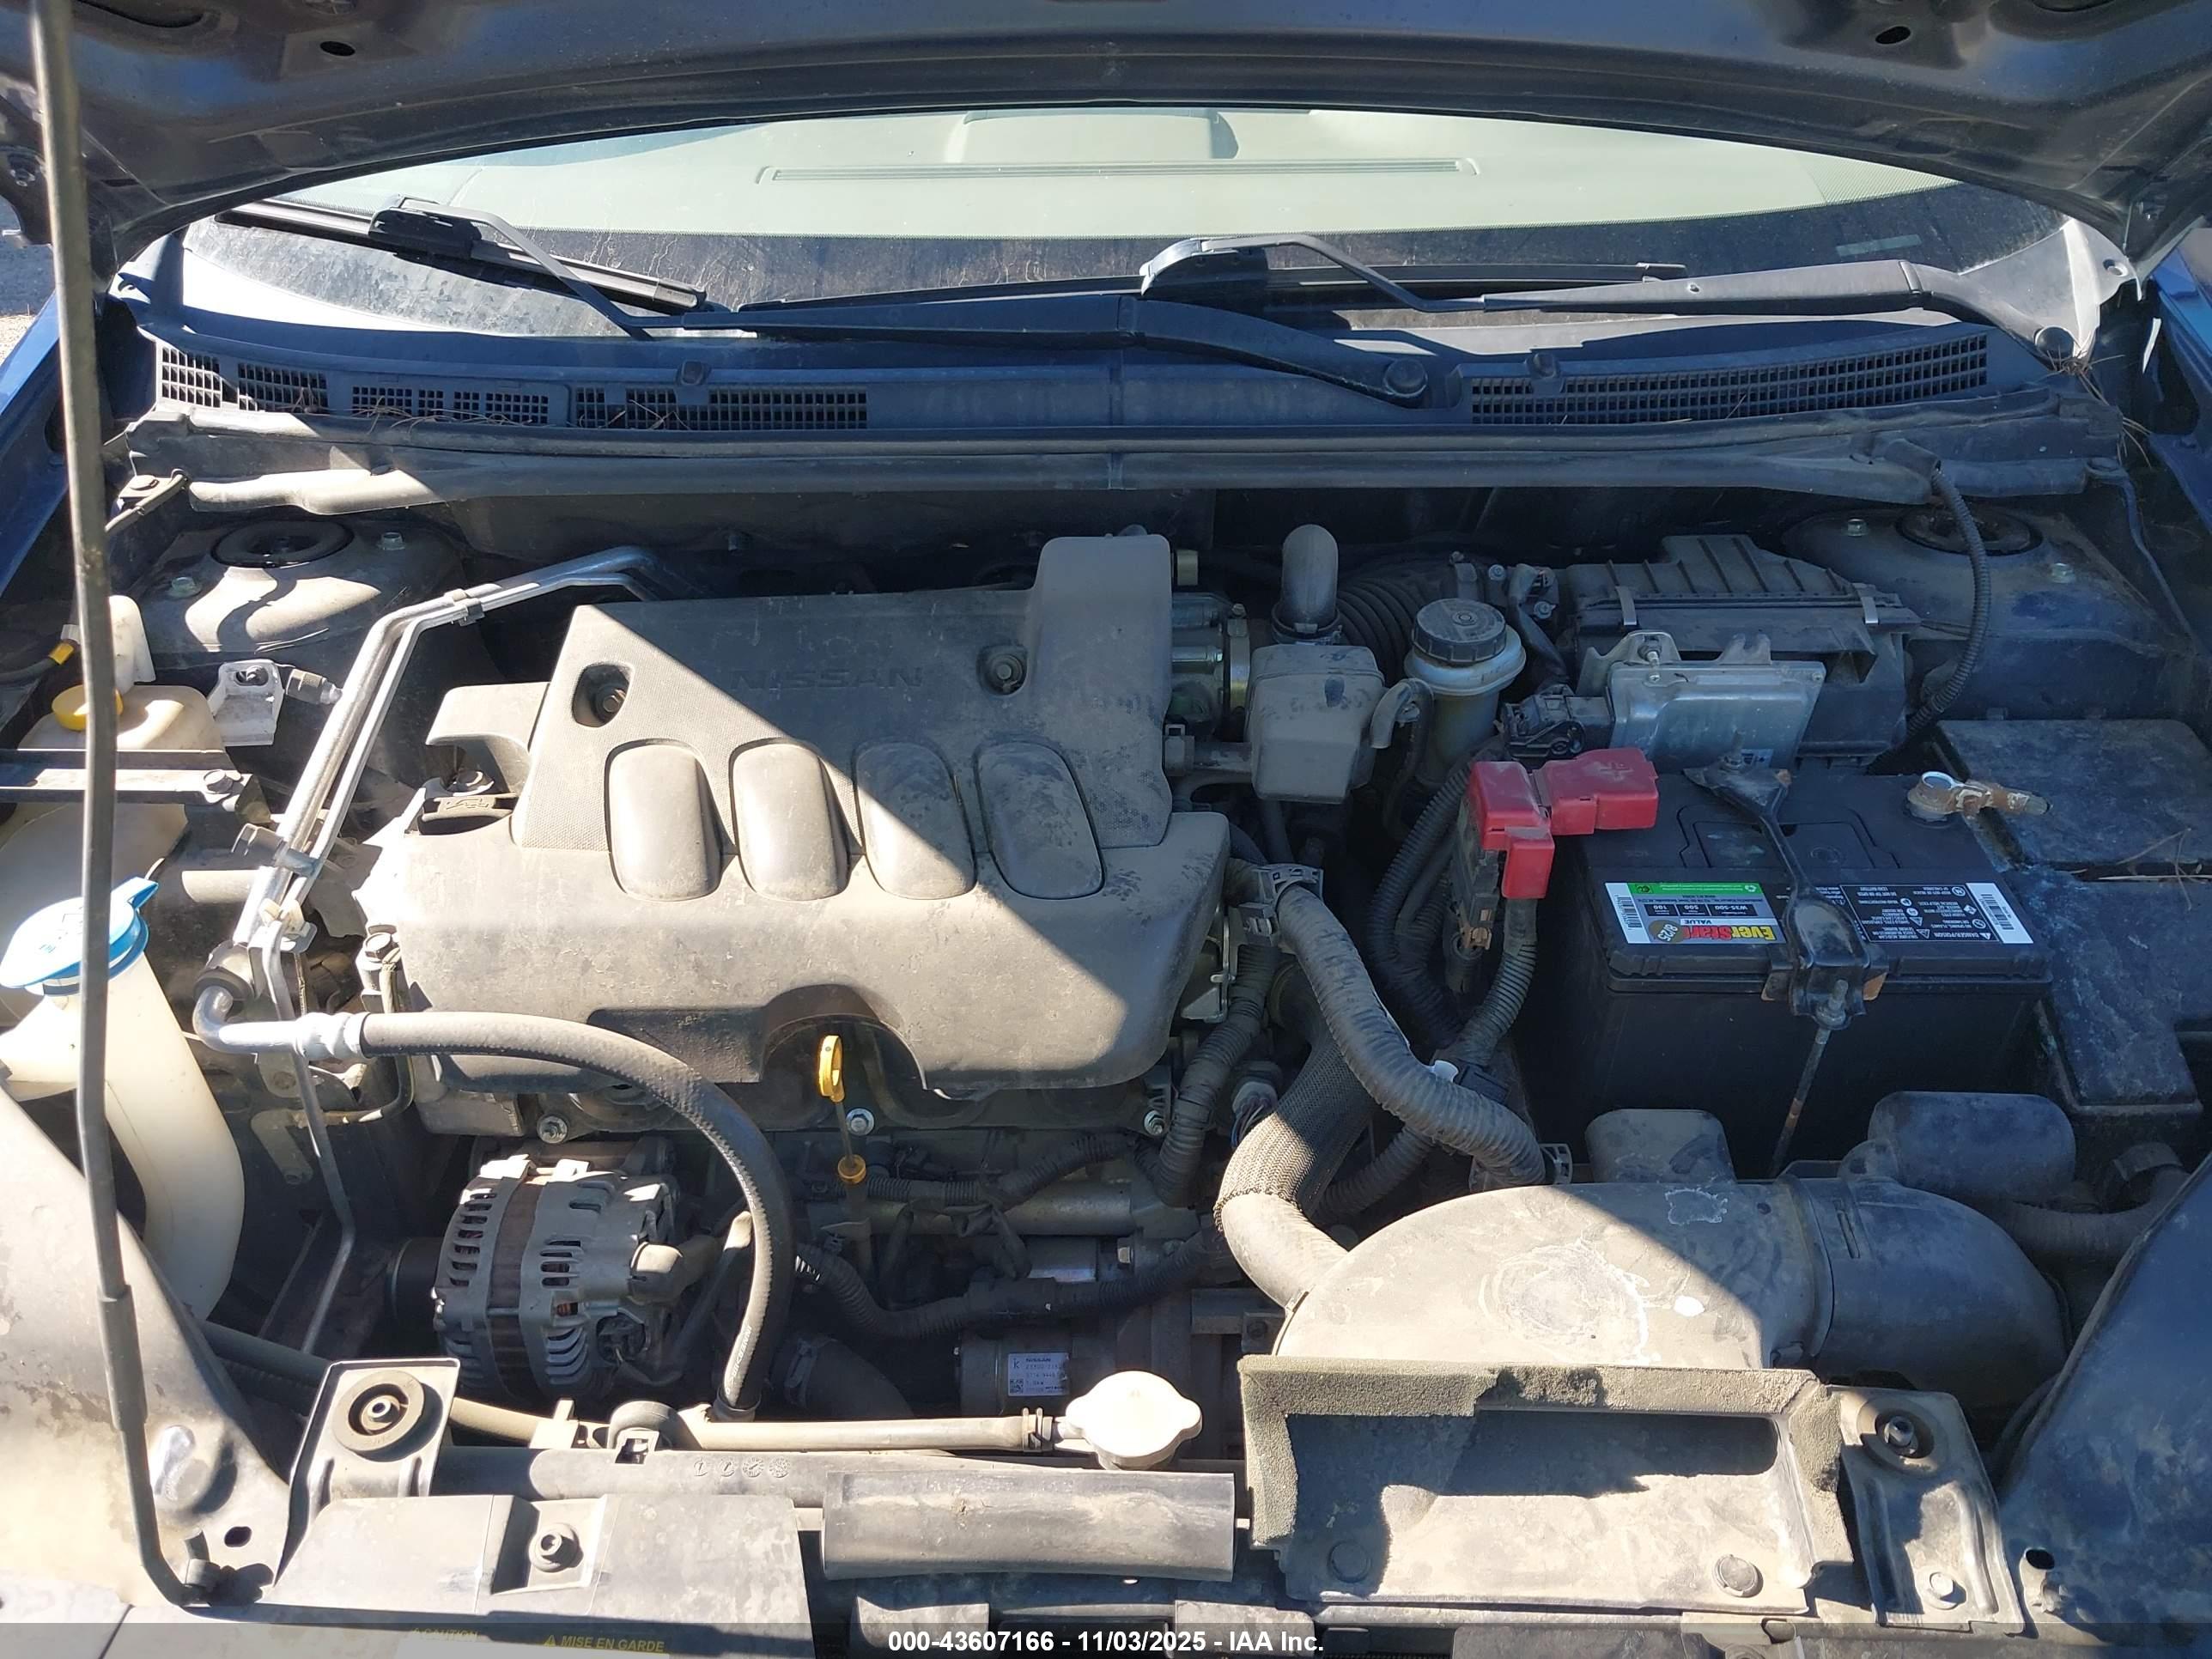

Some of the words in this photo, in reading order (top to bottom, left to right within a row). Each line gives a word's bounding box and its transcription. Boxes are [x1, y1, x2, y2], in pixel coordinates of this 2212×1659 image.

[730, 666, 923, 690] NISSAN
[1656, 924, 1679, 941] 8/25
[561, 1635, 593, 1648] MISE
[595, 1638, 615, 1650] EN
[618, 1638, 665, 1652] GARDE
